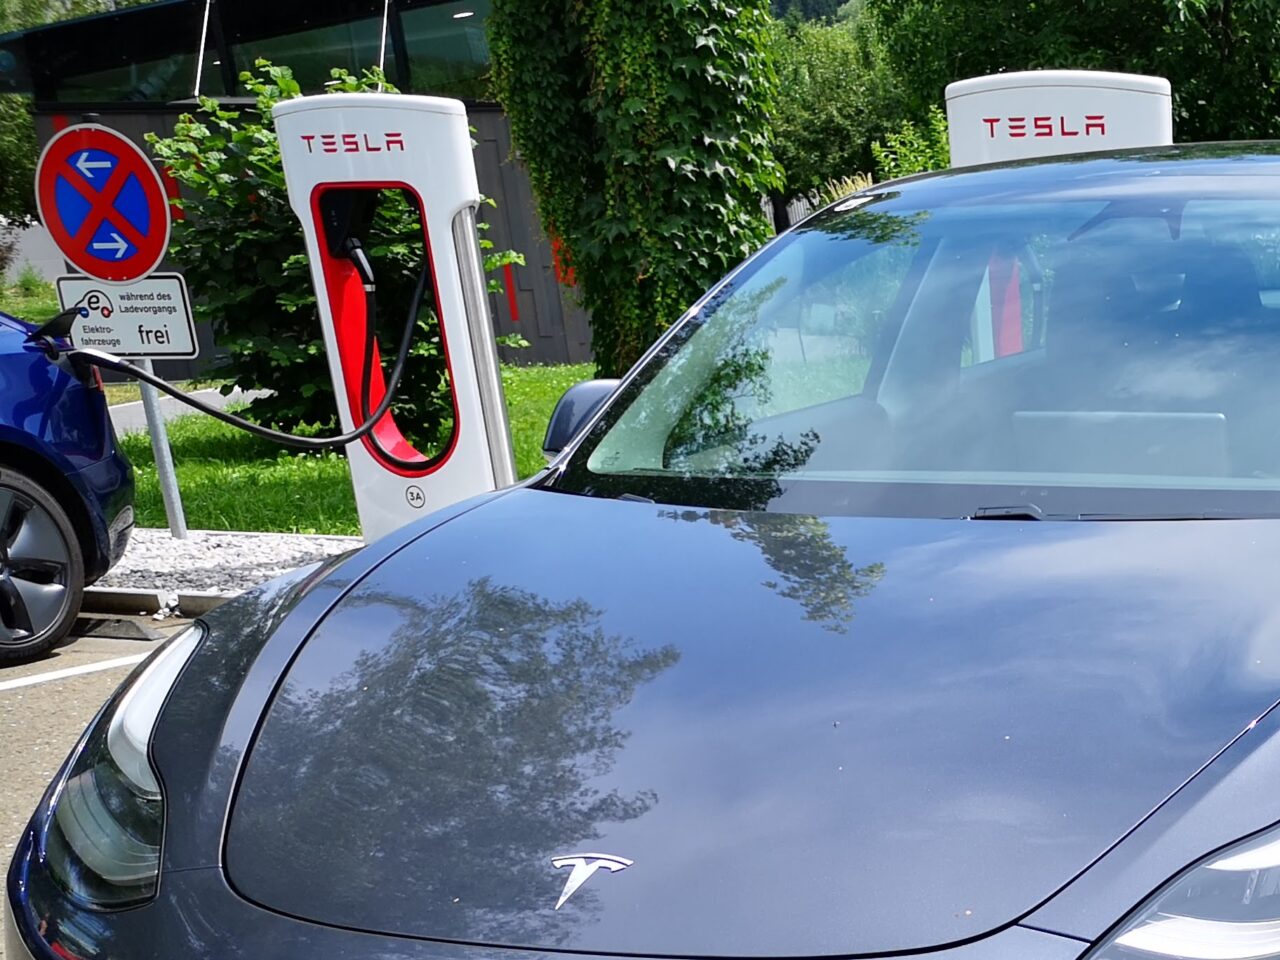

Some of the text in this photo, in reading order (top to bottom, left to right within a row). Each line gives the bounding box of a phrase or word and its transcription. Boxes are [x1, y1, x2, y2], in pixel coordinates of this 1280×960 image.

[984, 115, 1107, 138] TESLA
[300, 132, 405, 153] TESLA
[118, 292, 172, 301] während des
[118, 304, 178, 315] Ladevorgangs
[82, 325, 114, 334] Elektro-
[138, 324, 171, 345] frei
[80, 337, 121, 348] fahrzeuge
[408, 491, 423, 502] 3A
